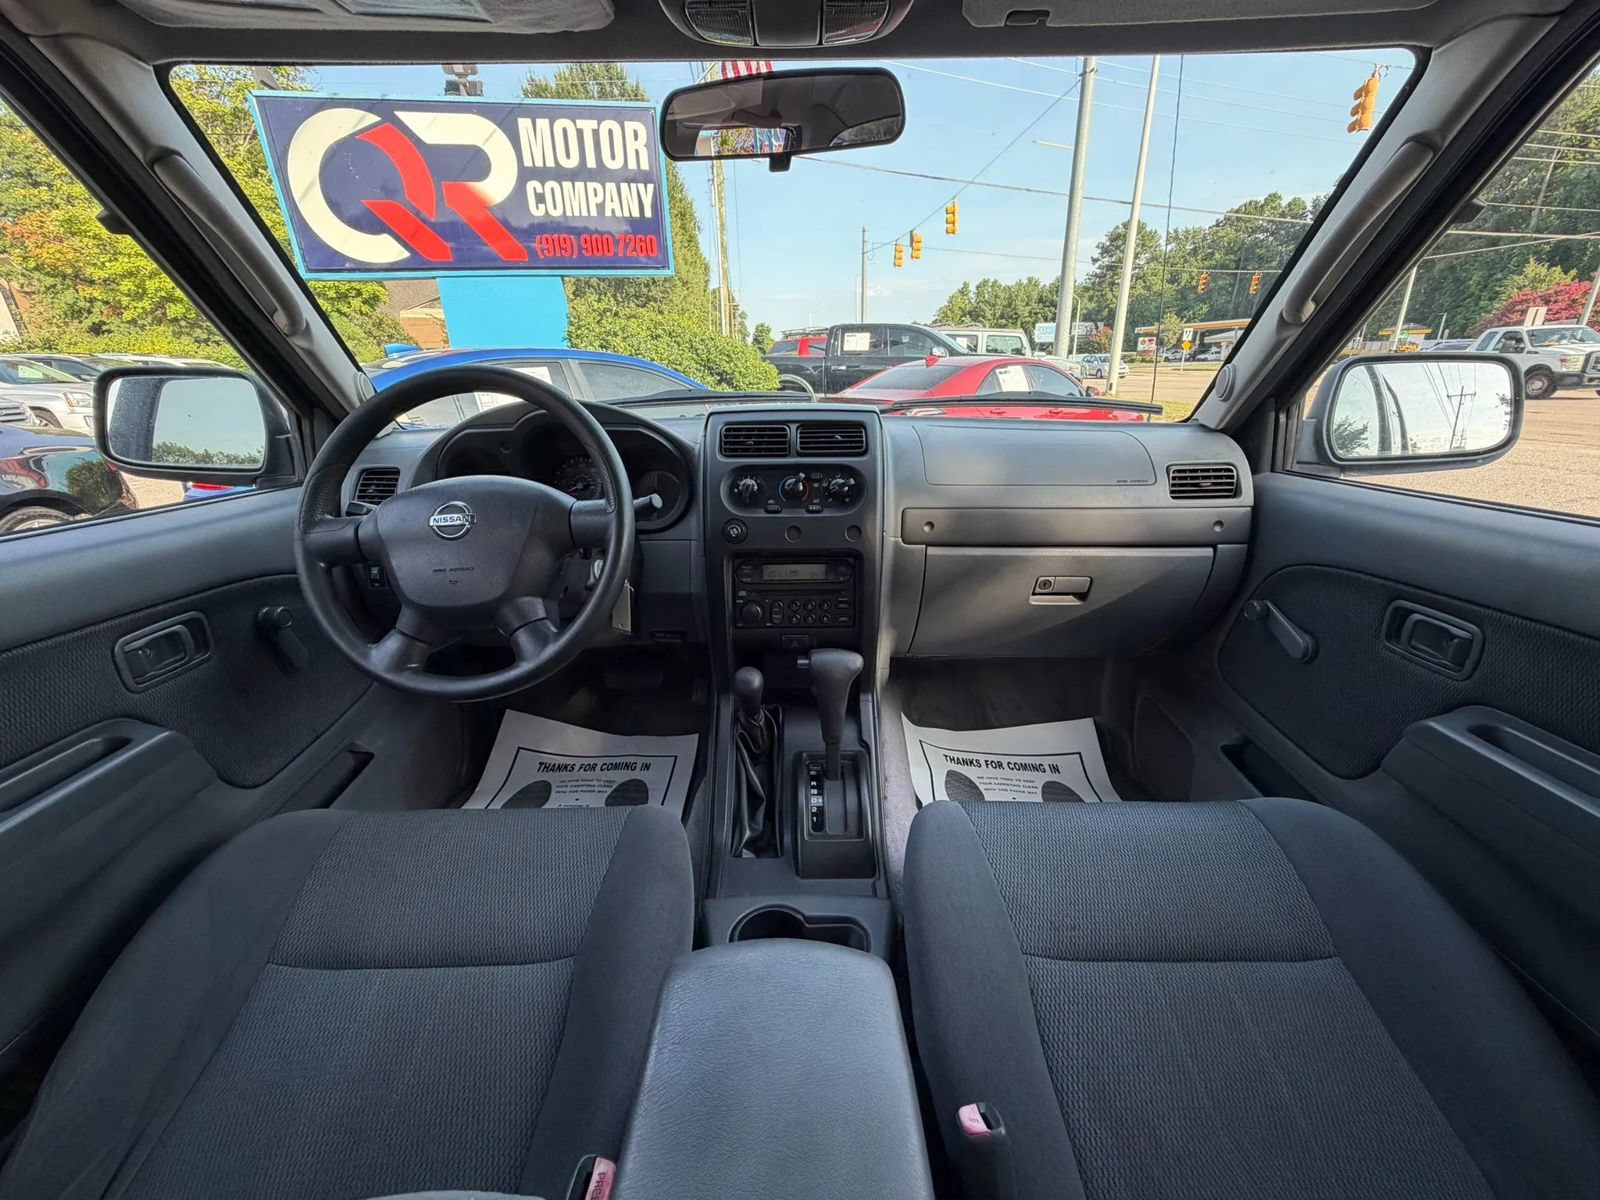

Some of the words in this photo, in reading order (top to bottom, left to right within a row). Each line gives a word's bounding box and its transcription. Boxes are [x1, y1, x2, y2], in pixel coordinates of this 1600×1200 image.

[517, 117, 649, 170] MOTOR
[287, 107, 528, 263] QR
[526, 180, 654, 218] COMPANY
[535, 234, 578, 259] (919)
[581, 234, 614, 257] 900
[615, 234, 658, 257] 7260
[432, 515, 471, 524] NISSAN
[536, 762, 576, 773] THANKS
[578, 762, 597, 773] FOR
[600, 761, 638, 772] COMING
[640, 762, 651, 772] IN
[943, 754, 982, 768] THANKS
[984, 759, 1005, 770] FOR
[1007, 761, 1046, 773] COMING
[1048, 763, 1061, 774] IN
